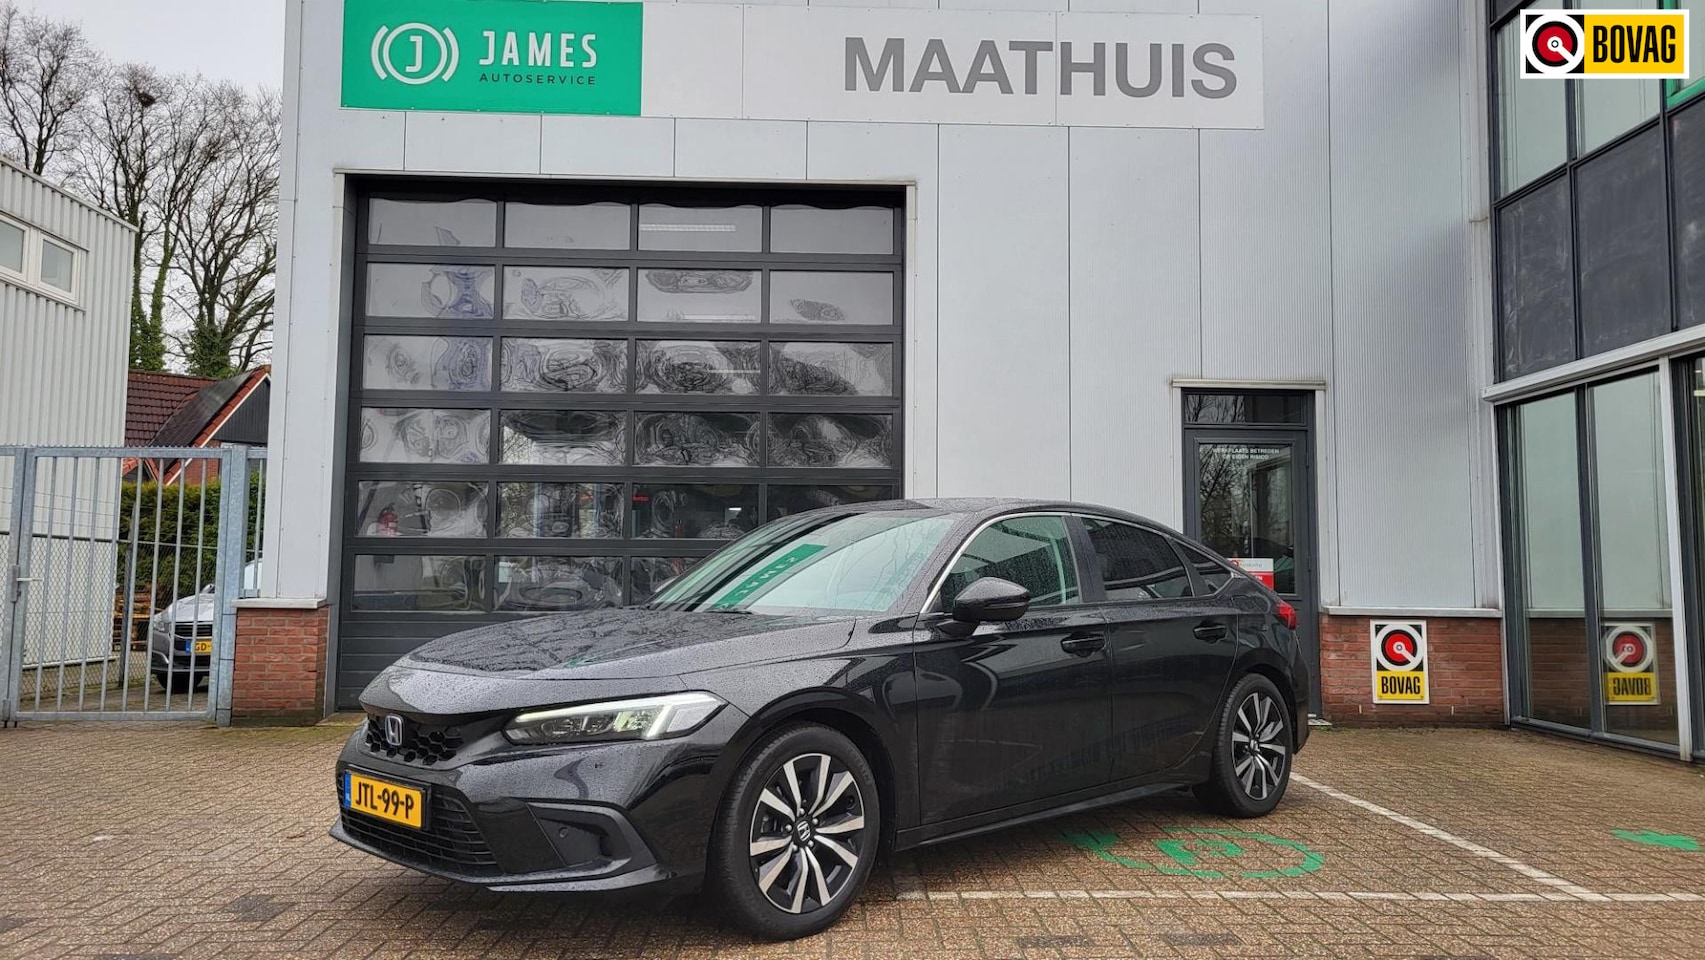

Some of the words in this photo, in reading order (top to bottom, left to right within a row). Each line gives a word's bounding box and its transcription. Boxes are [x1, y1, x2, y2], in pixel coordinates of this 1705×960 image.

[479, 30, 598, 69] JAMES
[845, 37, 1237, 99] MAATHUIS
[479, 72, 597, 85] AUTOSERVICE
[1381, 675, 1421, 695] BOVAG
[355, 782, 414, 819] JTL-99-P
